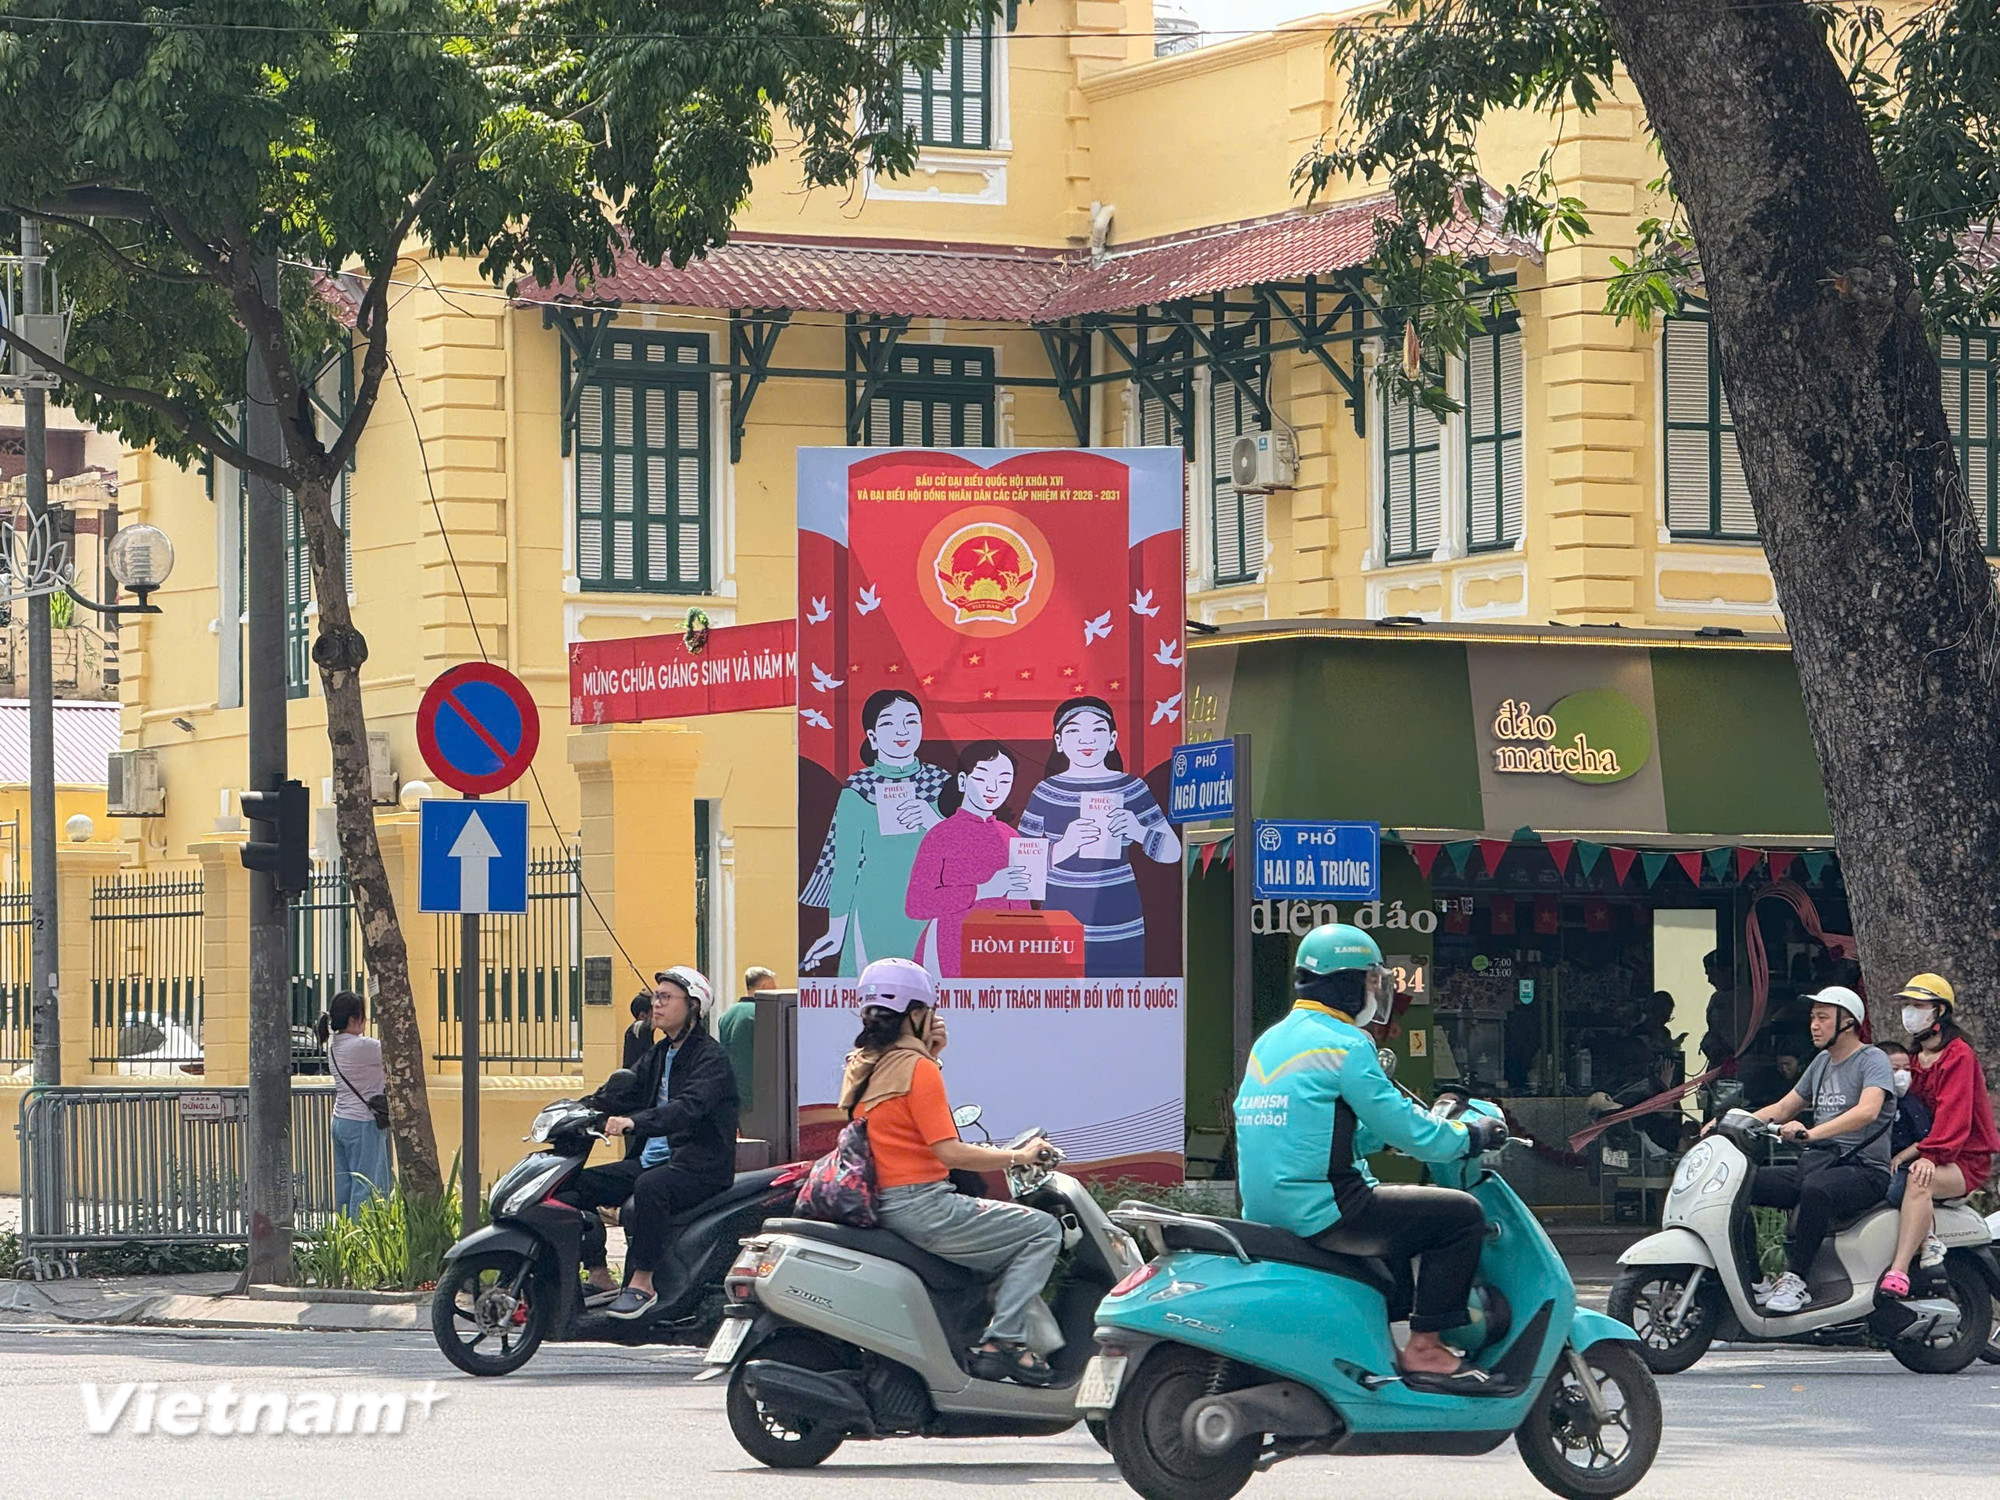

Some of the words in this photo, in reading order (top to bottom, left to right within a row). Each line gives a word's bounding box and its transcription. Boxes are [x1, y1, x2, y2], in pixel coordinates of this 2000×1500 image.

[1009, 474, 1024, 489] HỘI
[1025, 473, 1048, 487] KHÓA
[1050, 475, 1064, 487] XVI
[857, 488, 868, 501] VÀ
[948, 488, 972, 501] NHÂN
[993, 487, 1010, 501] CÁC
[1030, 488, 1058, 503] NHIỆM
[1073, 490, 1093, 501] 2026
[1100, 490, 1120, 501] 2031
[621, 660, 656, 693] CHÚA
[658, 657, 699, 690] GIÁNG
[701, 658, 730, 686] SINH
[732, 649, 751, 682] VÀ
[753, 648, 783, 680] NĂM
[1495, 699, 1557, 740] đảo
[1195, 748, 1218, 768] PHỐ
[1497, 733, 1621, 774] matcha
[1174, 778, 1196, 811] NGÔ
[1199, 770, 1233, 810] QUYỀN
[1297, 827, 1337, 846] PHỐ
[1264, 859, 1290, 885] HAI
[1295, 854, 1315, 886] BÀ
[1320, 858, 1370, 887] TRƯNG
[1353, 900, 1438, 934] đảo
[970, 935, 1014, 953] HÒM
[1019, 935, 1075, 954] PHIẾU
[1489, 967, 1512, 978] 23:00
[800, 981, 822, 1009] MỖI
[825, 984, 839, 1009] LÁ
[954, 988, 975, 1011] TIN,
[978, 984, 1002, 1013] MỘT
[1005, 984, 1041, 1009] TRÁCH
[1045, 984, 1081, 1013] NHIỆM
[1084, 981, 1103, 1009] ĐỐI
[1106, 982, 1124, 1009] VỚI
[1127, 980, 1142, 1009] TỔ
[1144, 981, 1178, 1010] QUỐC!
[1254, 1111, 1288, 1126] chào!
